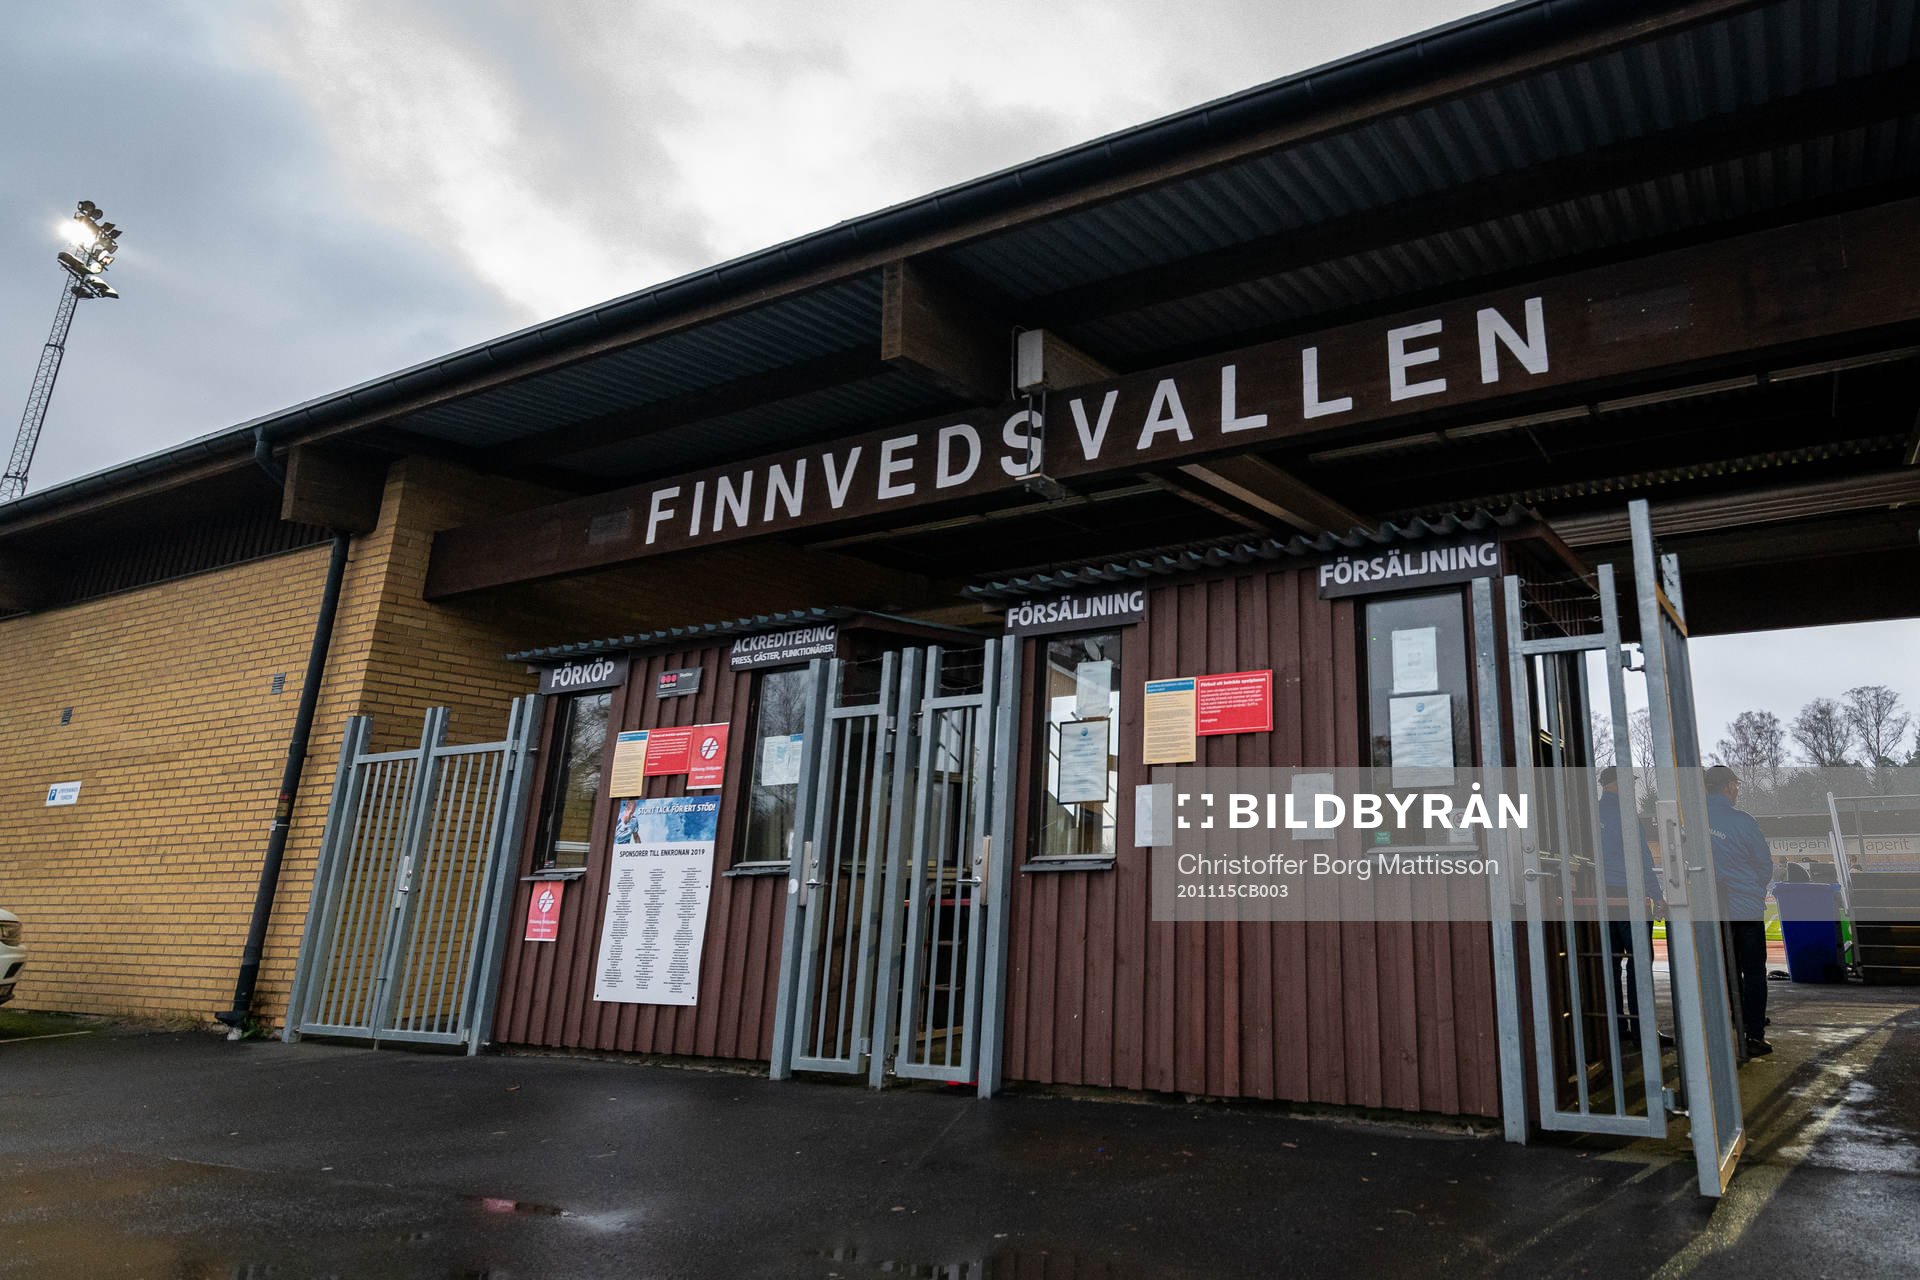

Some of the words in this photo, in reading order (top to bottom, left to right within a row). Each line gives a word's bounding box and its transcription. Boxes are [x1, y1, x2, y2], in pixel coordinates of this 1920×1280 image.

[644, 297, 1550, 545] FINNVEDSVALLEN
[1320, 542, 1498, 587] FÖRSÄLJNING
[1006, 590, 1144, 628] FÖRSÄLJNING
[732, 625, 835, 653] ACKREDITERING
[731, 655, 753, 666] PRESS,
[753, 651, 780, 662] GÄSTER,
[781, 643, 834, 659] FUNKTIONÄRER
[551, 658, 615, 688] FÖRKÖP
[638, 808, 656, 816] STORT
[672, 804, 684, 813] FÖR
[684, 804, 697, 813] ERT
[697, 802, 715, 811] STÖD!
